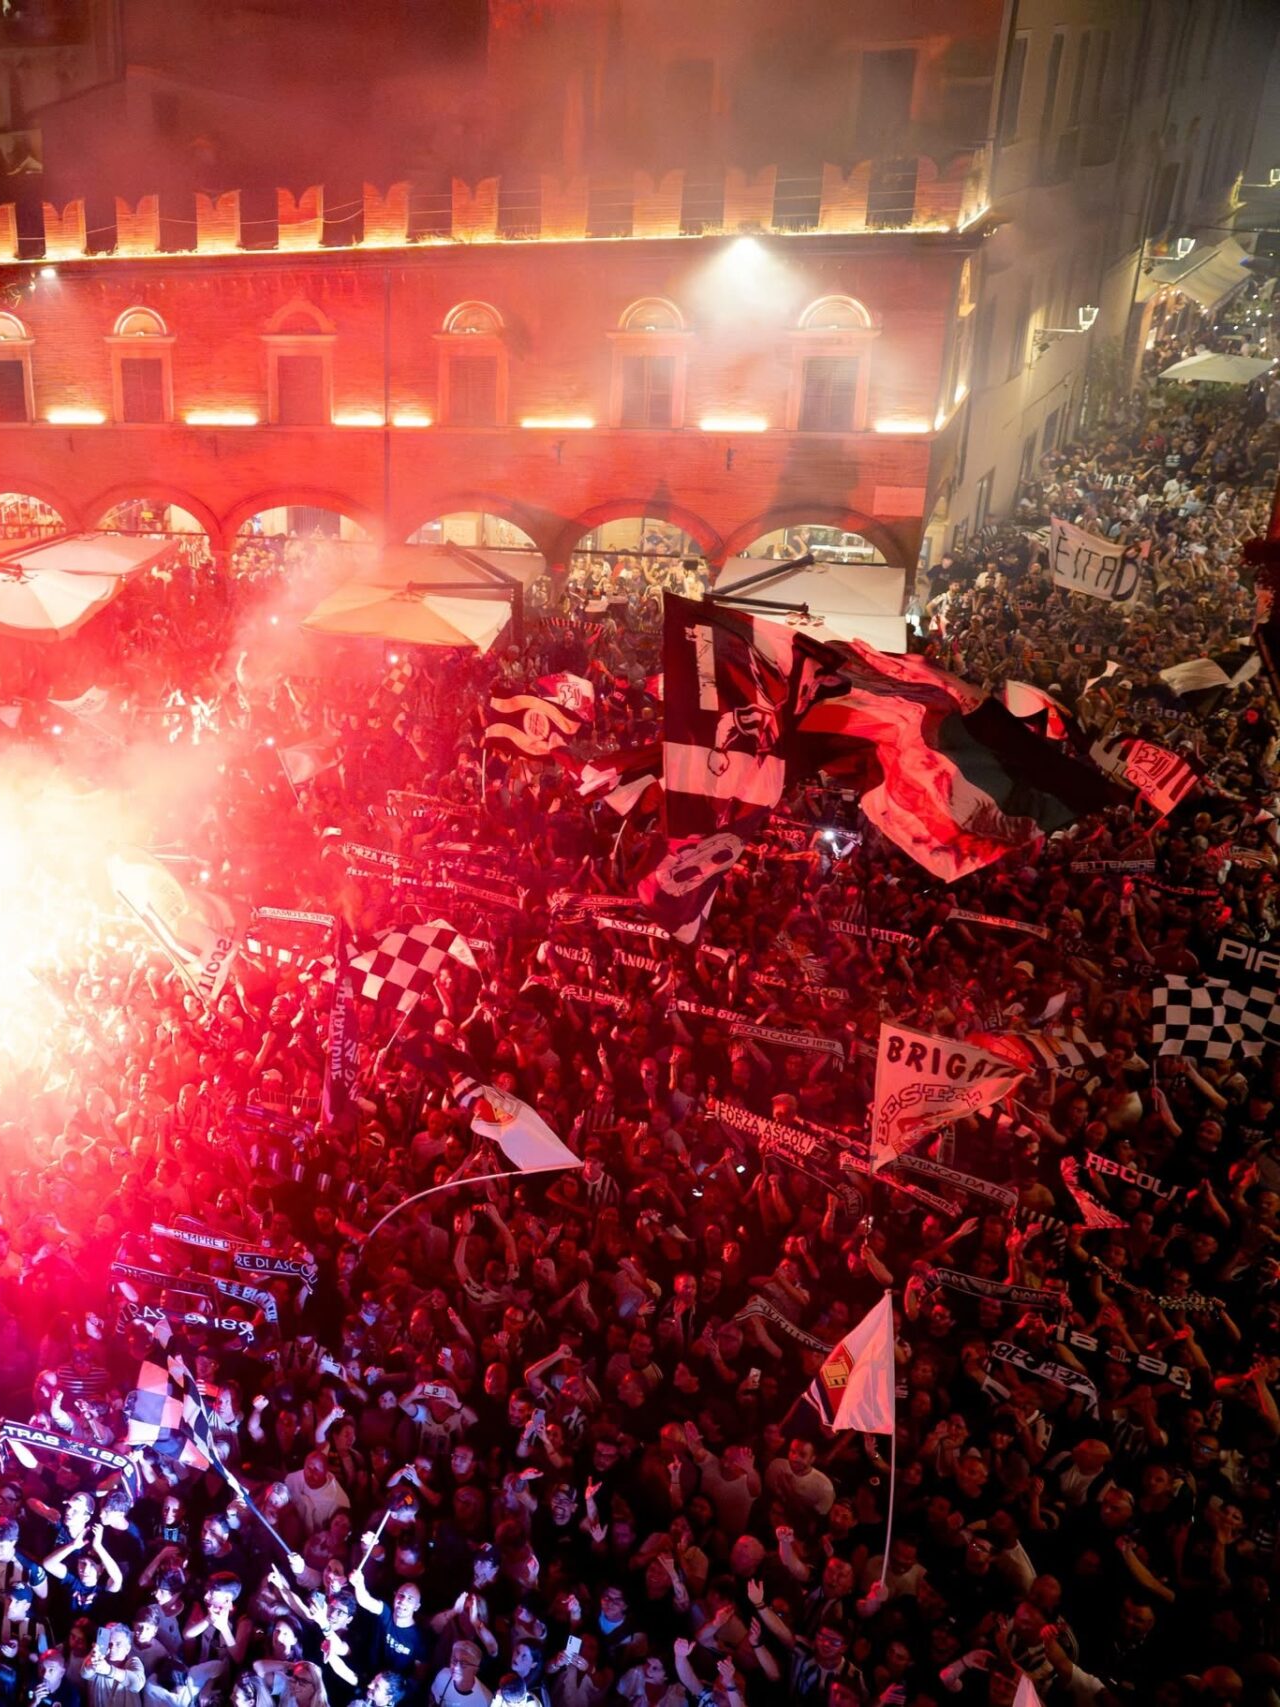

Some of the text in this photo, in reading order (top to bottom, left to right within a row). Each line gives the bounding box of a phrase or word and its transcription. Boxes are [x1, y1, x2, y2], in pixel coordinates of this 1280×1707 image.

[720, 1101, 760, 1132] FORZA
[763, 1125, 813, 1151] ASCOLI
[1084, 1150, 1183, 1201] ASCOLI
[964, 1177, 986, 1192] DA
[988, 1187, 1008, 1201] TE
[255, 1257, 270, 1269] DI
[3, 1425, 61, 1447] TRAS
